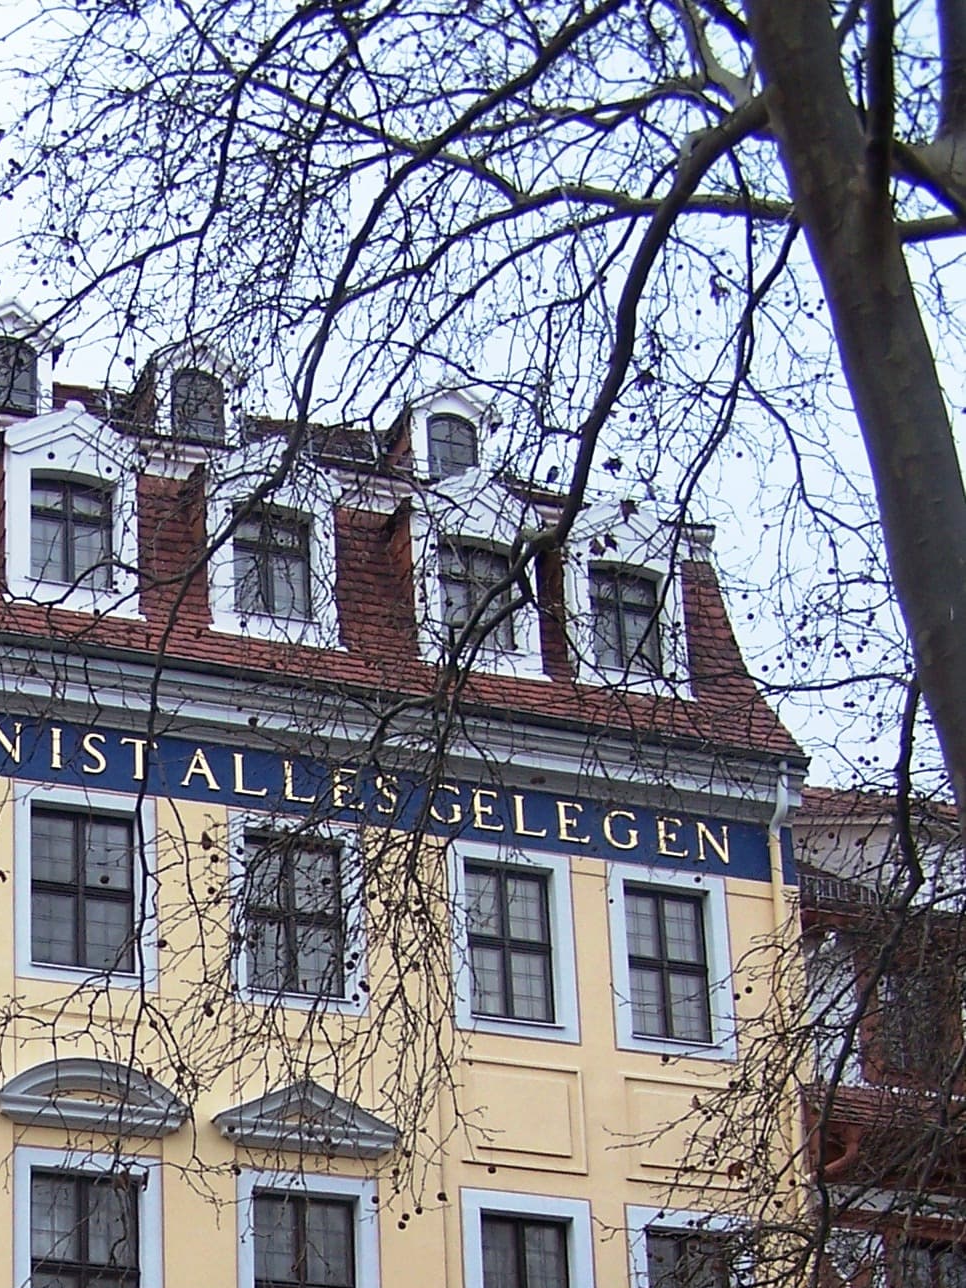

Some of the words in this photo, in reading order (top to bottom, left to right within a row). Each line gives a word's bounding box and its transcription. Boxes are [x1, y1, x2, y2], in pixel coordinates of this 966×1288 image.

[50, 728, 159, 780] IST
[181, 748, 399, 814] ALLES
[429, 783, 731, 864] GELEGEN
